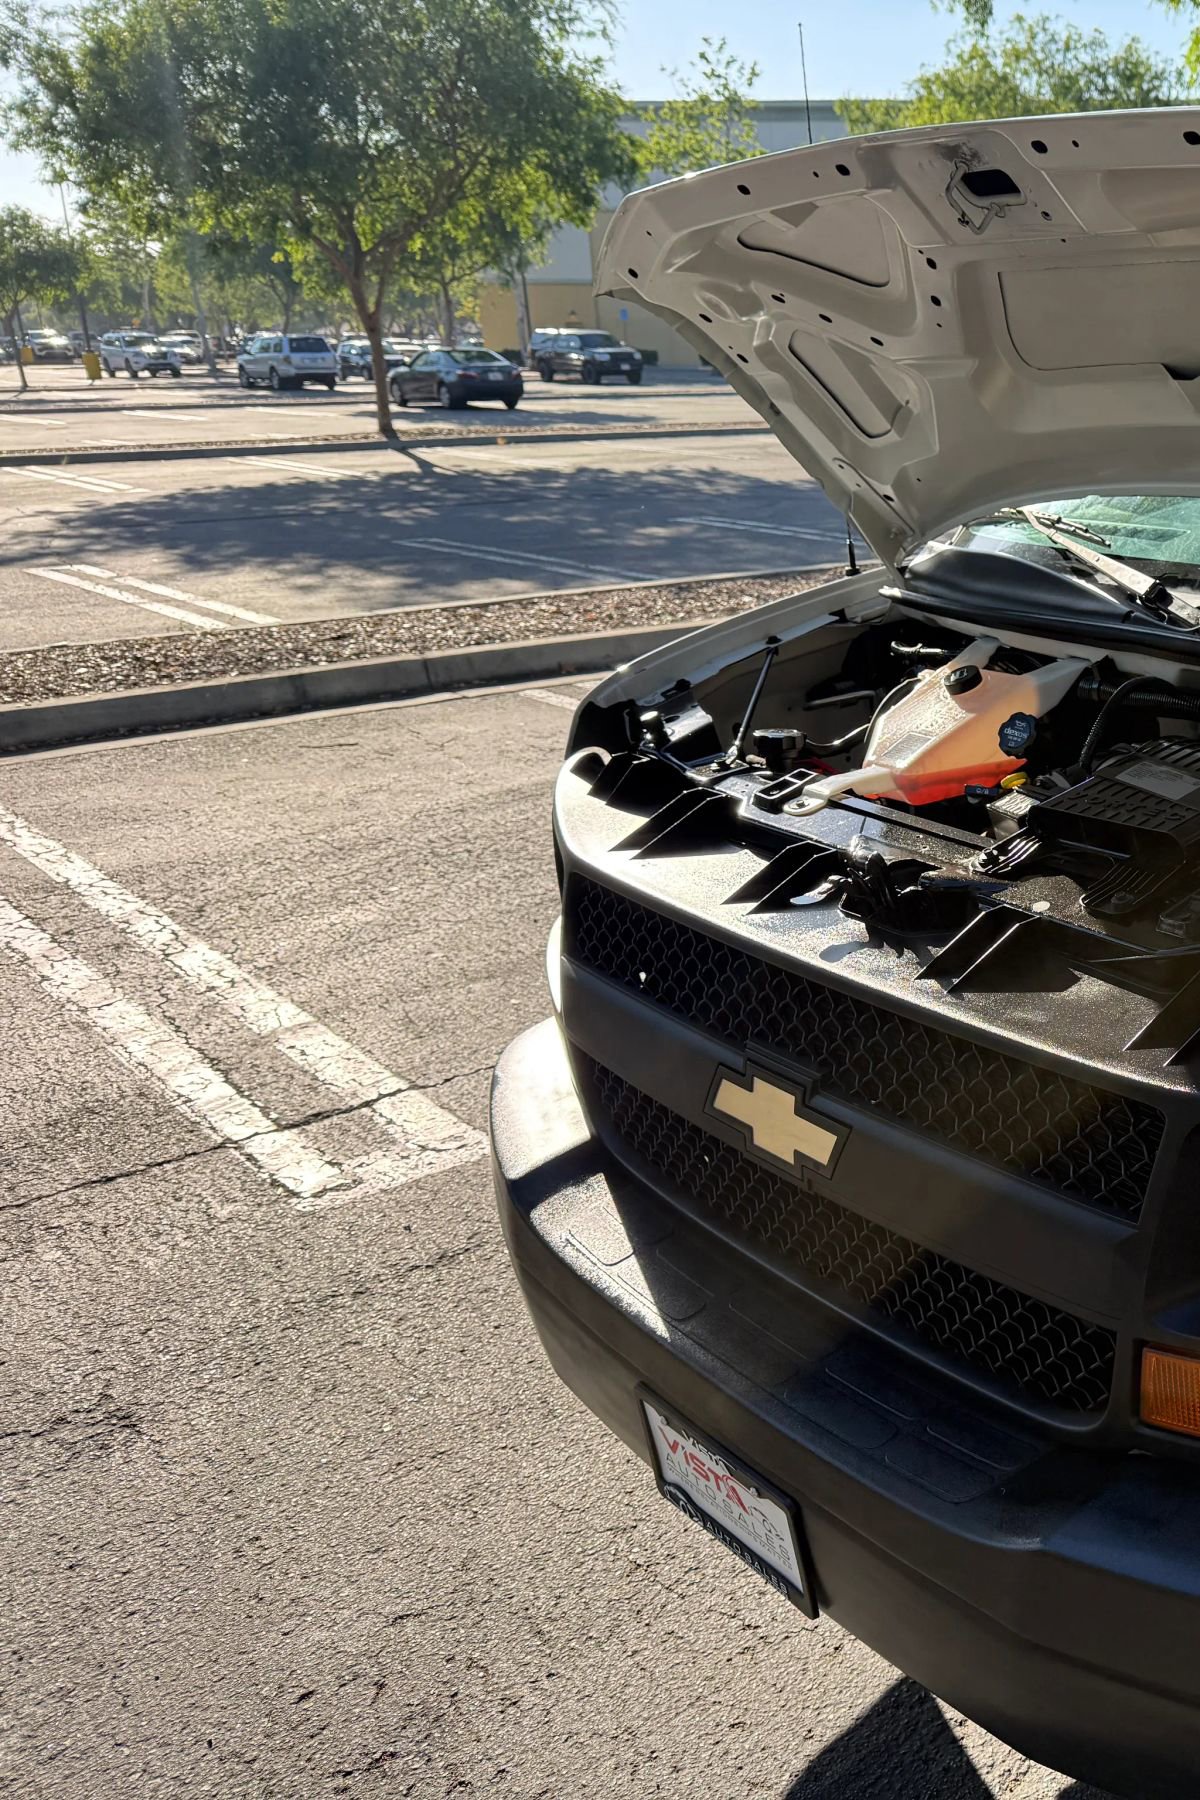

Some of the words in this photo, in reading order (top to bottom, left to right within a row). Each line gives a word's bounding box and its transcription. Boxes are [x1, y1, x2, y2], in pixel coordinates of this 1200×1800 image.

[658, 1424, 751, 1516] VISTA
[665, 1451, 717, 1501] AUTO
[722, 1498, 791, 1561] SALES
[705, 1520, 742, 1554] AUTO
[743, 1552, 789, 1595] SALES
